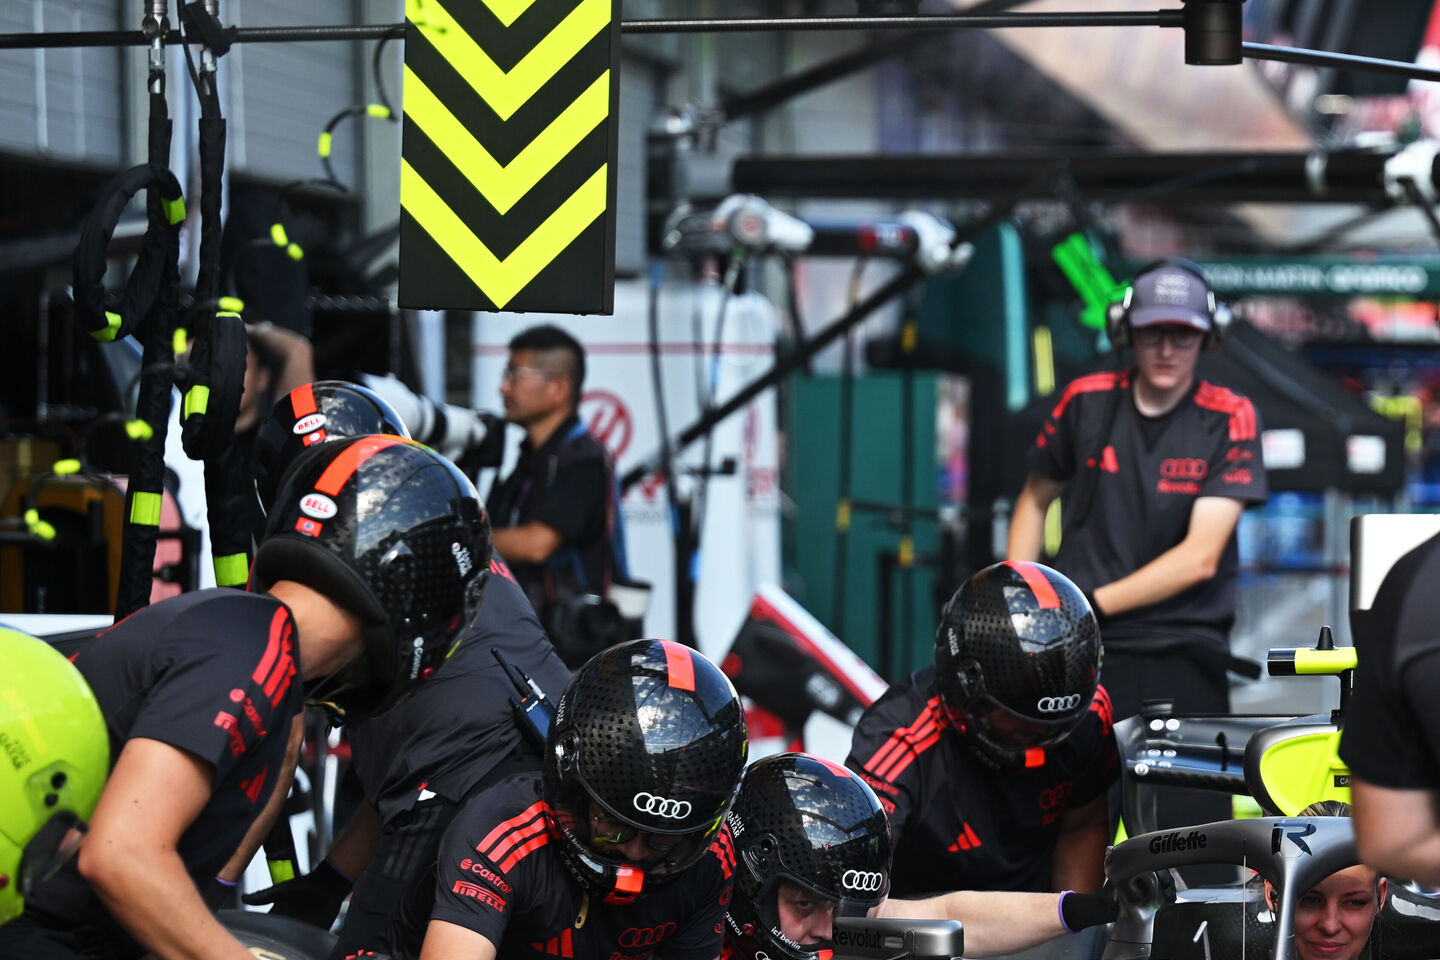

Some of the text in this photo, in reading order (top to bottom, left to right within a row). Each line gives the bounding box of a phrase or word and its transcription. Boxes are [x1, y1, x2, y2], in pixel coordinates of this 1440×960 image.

[304, 497, 330, 514] BELL
[727, 810, 740, 839] QATAR
[735, 813, 745, 834] visit
[1150, 830, 1208, 854] Gillette
[471, 863, 513, 894] Castrol
[451, 880, 507, 913] PIRELLI
[725, 911, 742, 937] astrol
[780, 934, 801, 950] berlin
